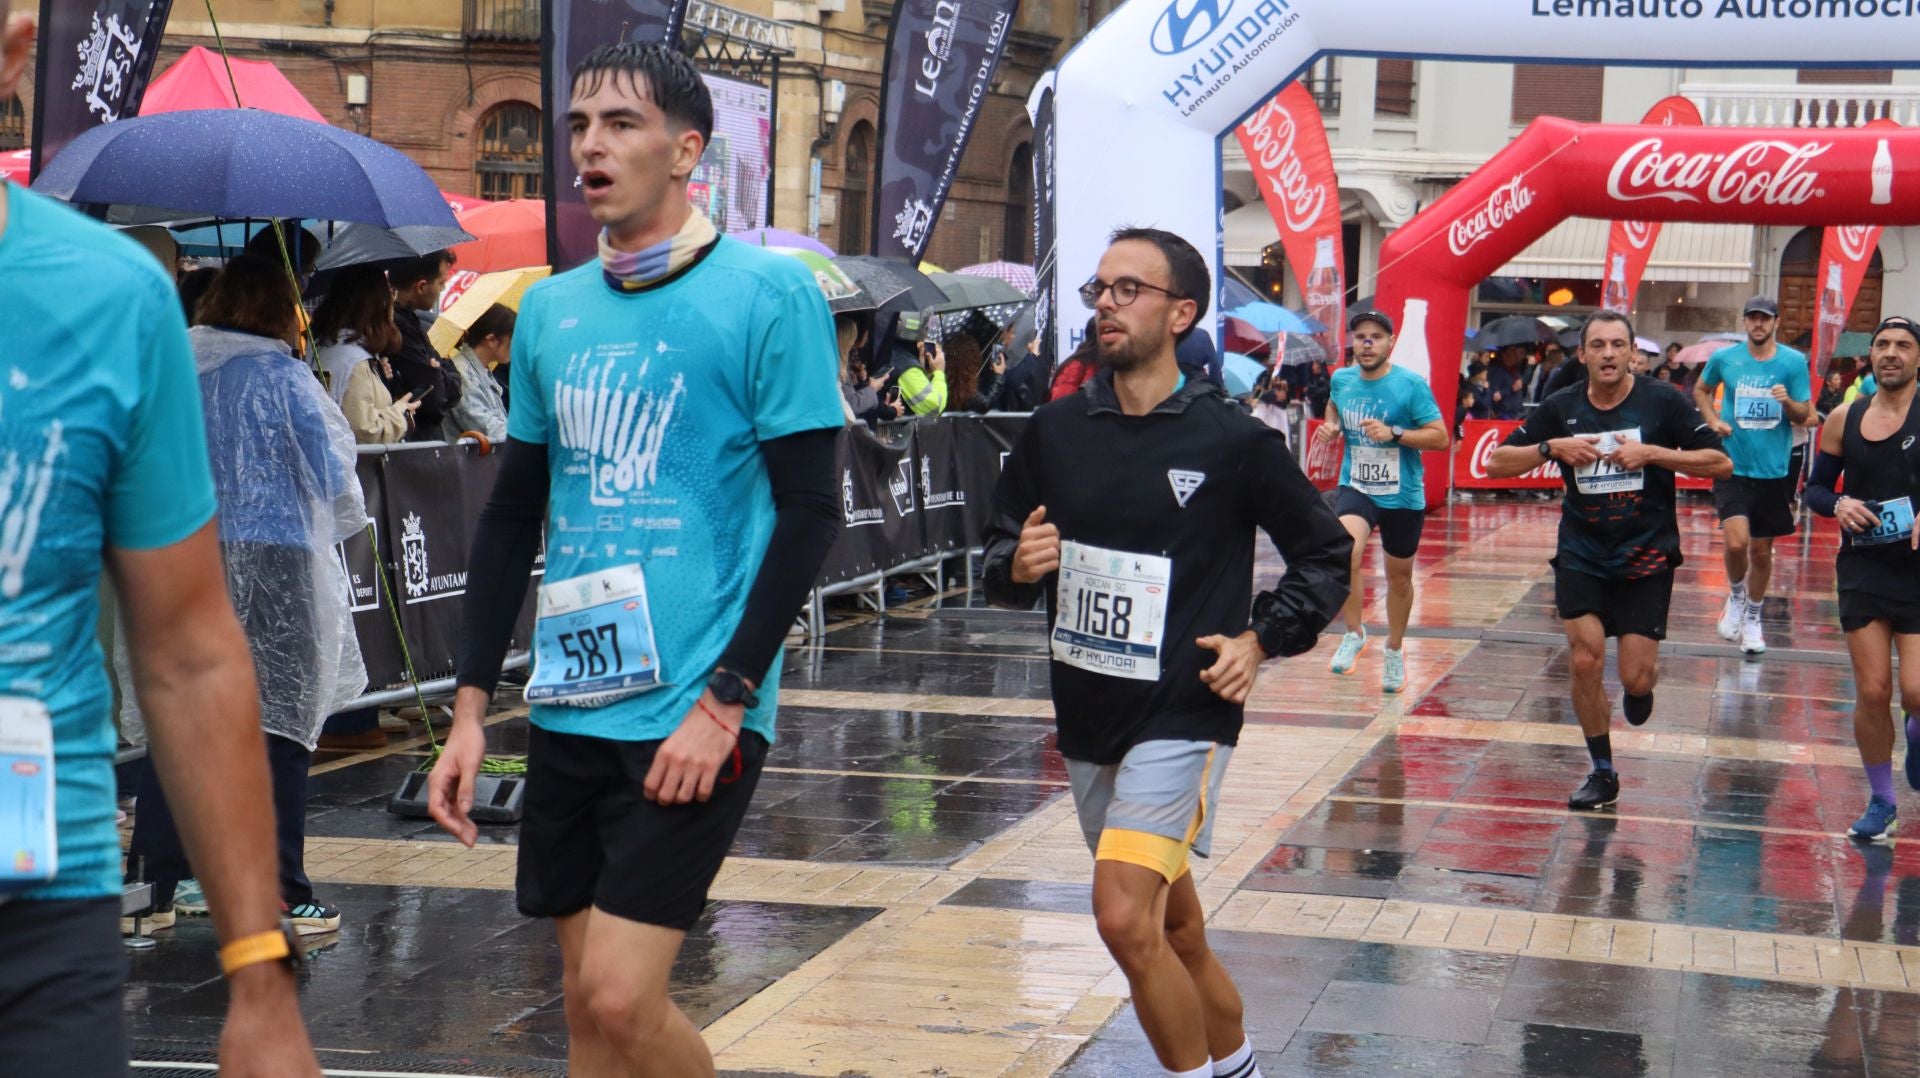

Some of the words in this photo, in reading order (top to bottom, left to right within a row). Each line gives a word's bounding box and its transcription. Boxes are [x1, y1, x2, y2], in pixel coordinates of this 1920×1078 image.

[1532, 0, 1701, 17] Lemauto
[1714, 0, 1920, 18] Automoci
[978, 57, 991, 79] DE
[986, 11, 1006, 54] LEÓN
[1181, 74, 1231, 117] Lemauto
[1233, 11, 1300, 75] Automoción
[1607, 138, 1834, 205] Coca-Cola
[1448, 173, 1532, 256] Coca-Cola
[1748, 402, 1769, 417] 451
[1359, 463, 1390, 481] 1034
[1600, 480, 1632, 488] HYUNDAI
[353, 574, 361, 584] ES
[430, 571, 468, 591] AYUNTAM
[1085, 577, 1111, 590] ADRIAN
[1114, 582, 1126, 593] SG
[356, 586, 373, 597] DEPORTE
[1076, 587, 1133, 640] 1158
[557, 622, 623, 681] 587
[1086, 650, 1136, 669] HYUNDAI
